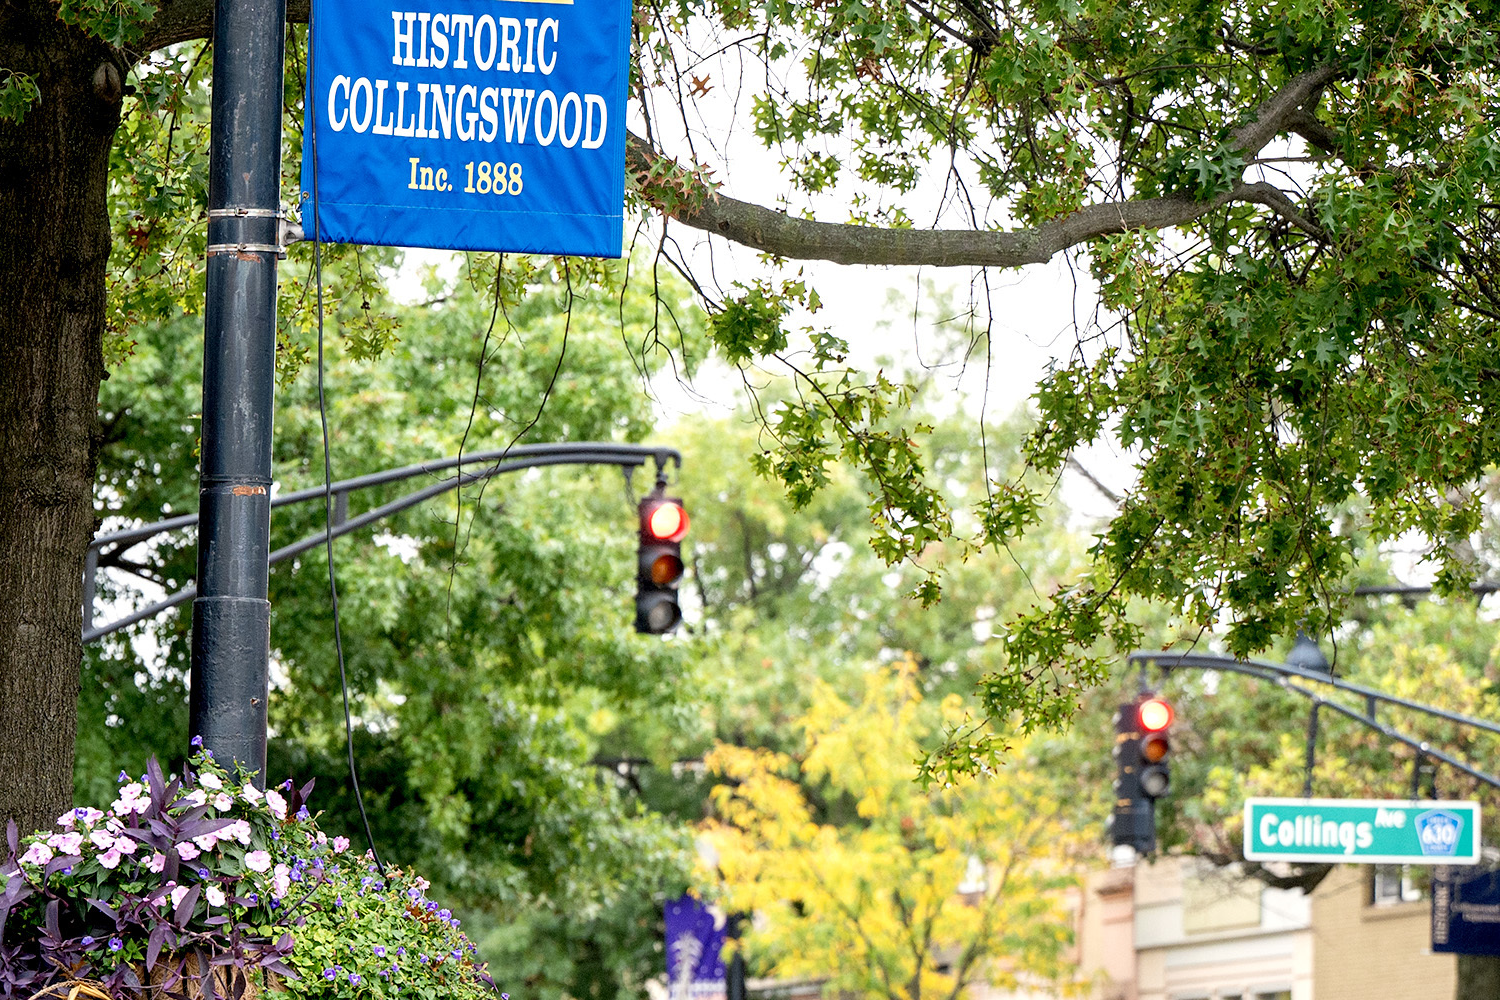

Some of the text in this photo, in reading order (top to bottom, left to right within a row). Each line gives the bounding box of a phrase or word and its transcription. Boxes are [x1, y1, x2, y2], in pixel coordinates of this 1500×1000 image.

[392, 11, 559, 76] HISTORIC
[327, 74, 608, 150] COLLINGSWOOD
[408, 157, 523, 196] Inc. 1888
[1259, 807, 1456, 856] Collings Ave 630
